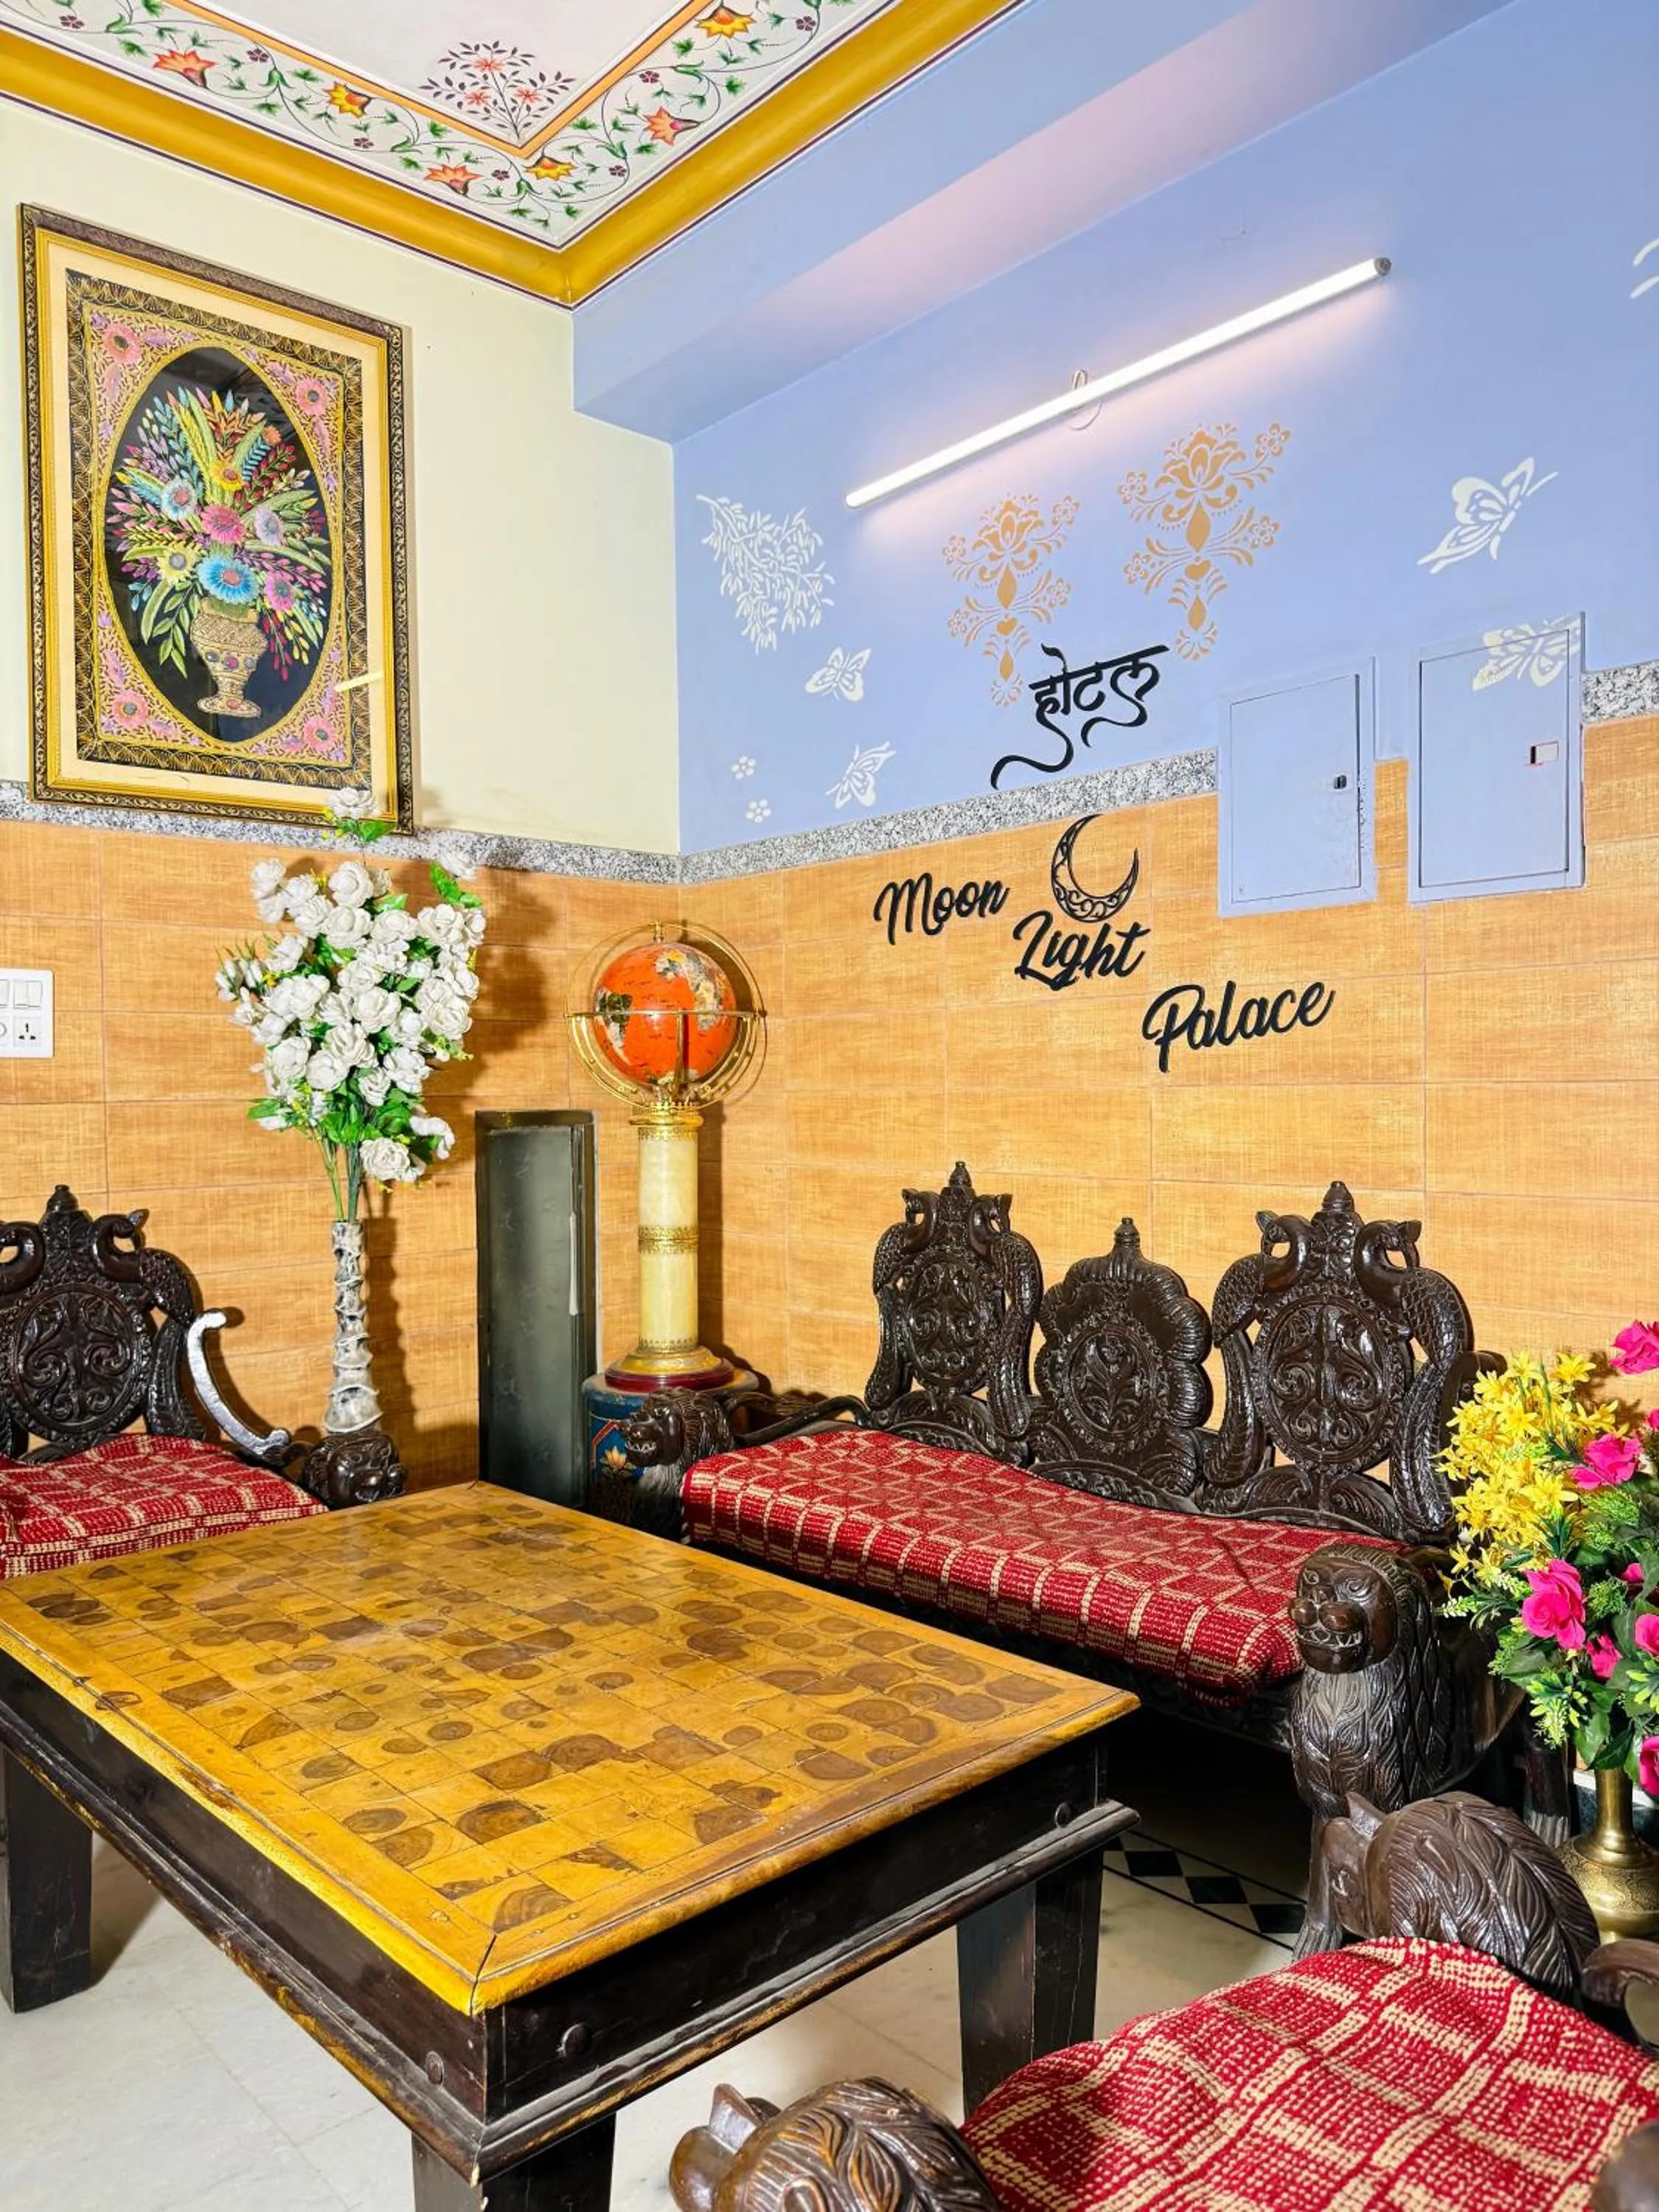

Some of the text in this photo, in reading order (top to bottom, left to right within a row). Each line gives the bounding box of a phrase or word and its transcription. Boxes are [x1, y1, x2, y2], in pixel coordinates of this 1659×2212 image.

[991, 644, 1169, 790] होटल
[873, 872, 1010, 945] Moon
[1012, 911, 1151, 991] Light
[1142, 980, 1335, 1073] Palace
